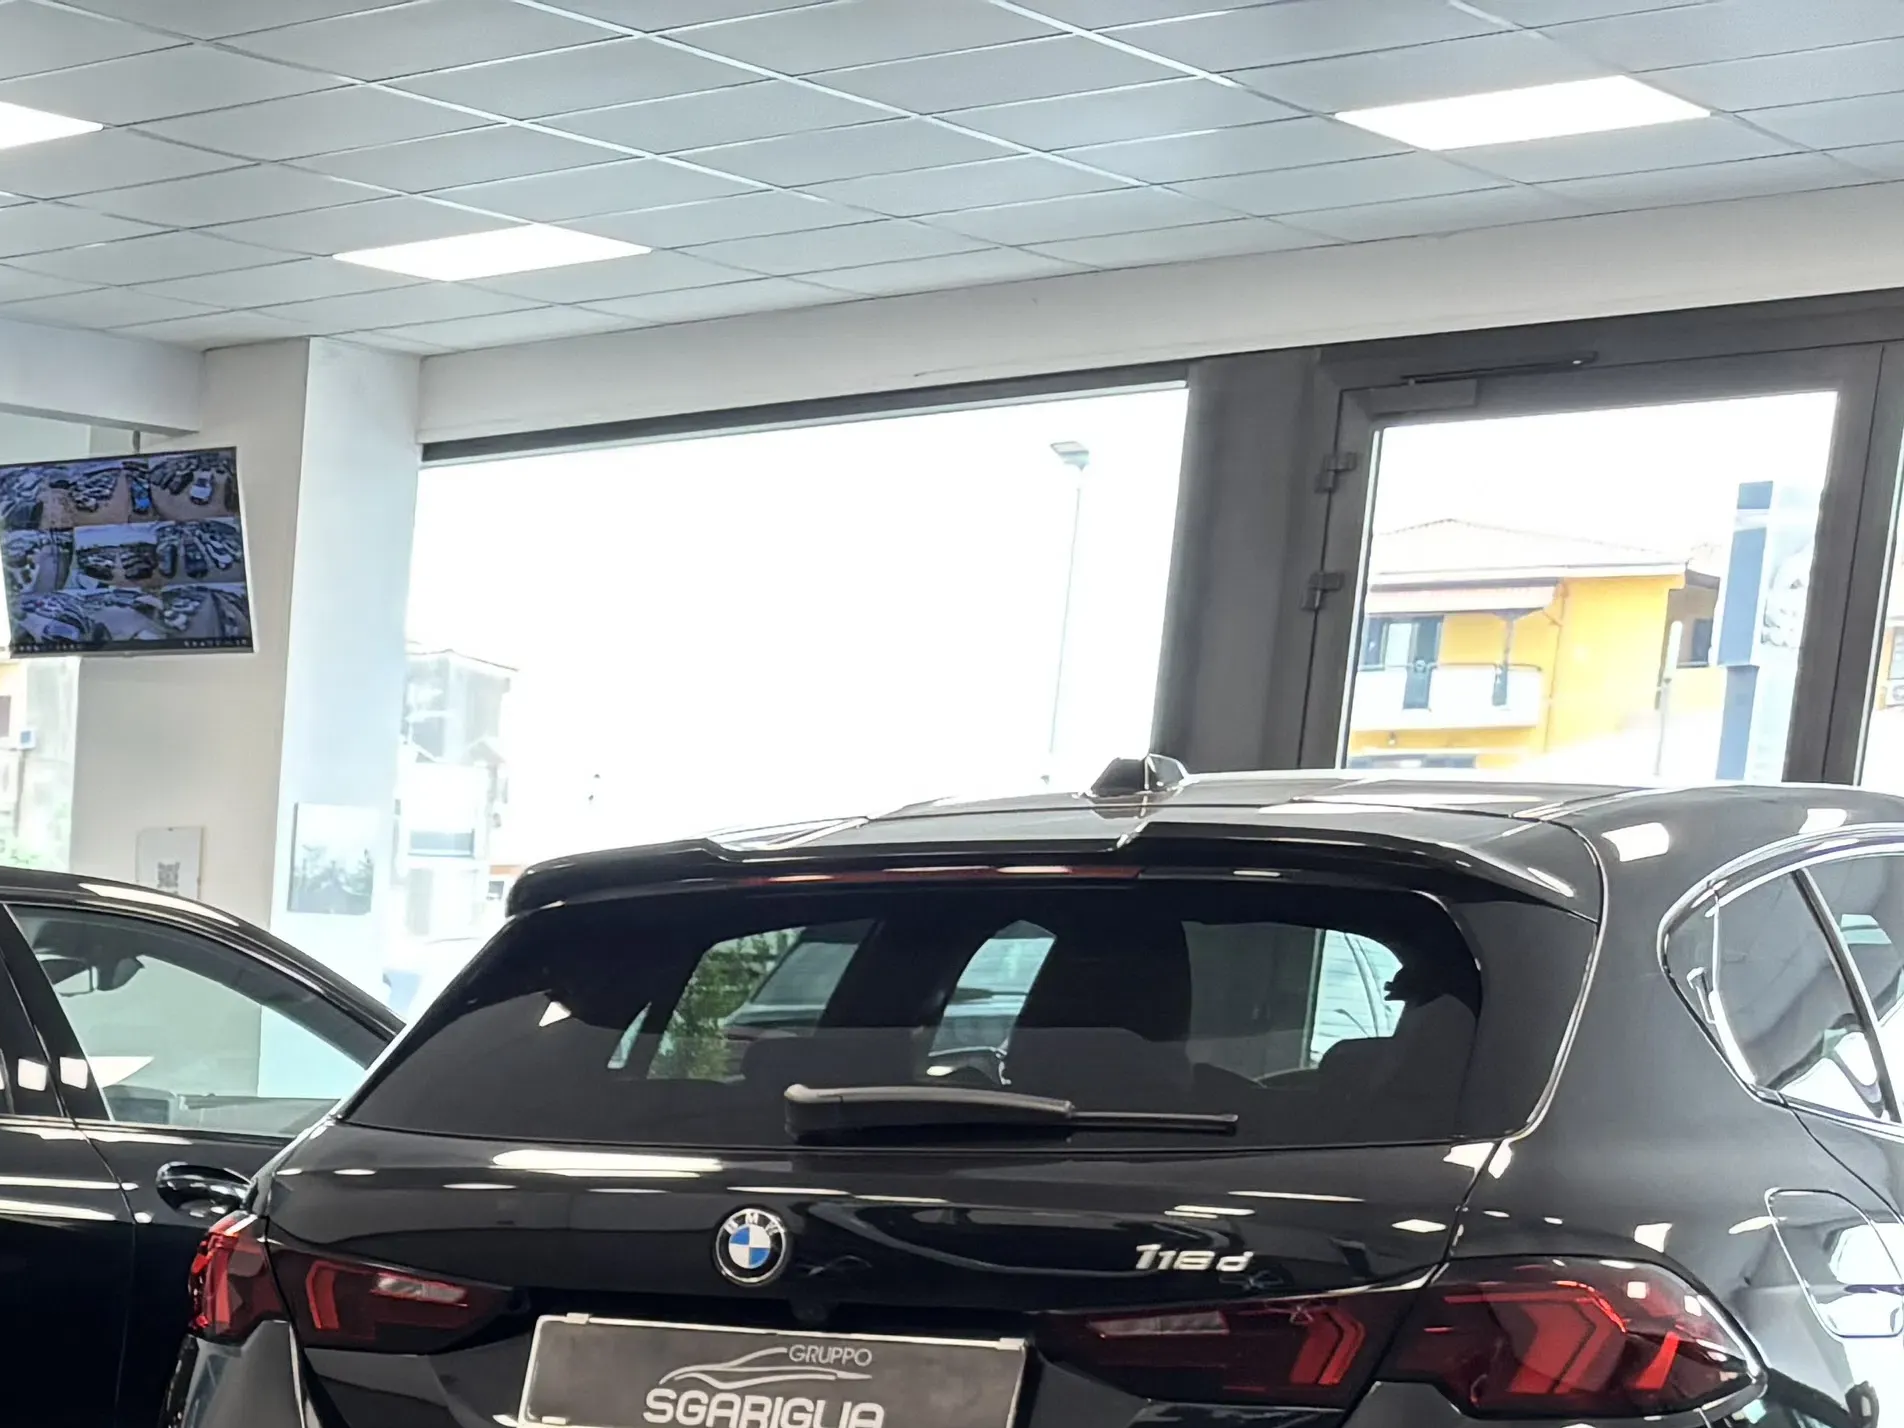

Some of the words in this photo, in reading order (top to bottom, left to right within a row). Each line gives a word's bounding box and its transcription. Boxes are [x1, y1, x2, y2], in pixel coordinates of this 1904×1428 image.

[723, 1211, 780, 1237] BMW
[1135, 1243, 1255, 1272] 118d
[788, 1344, 873, 1367] GRUPPO
